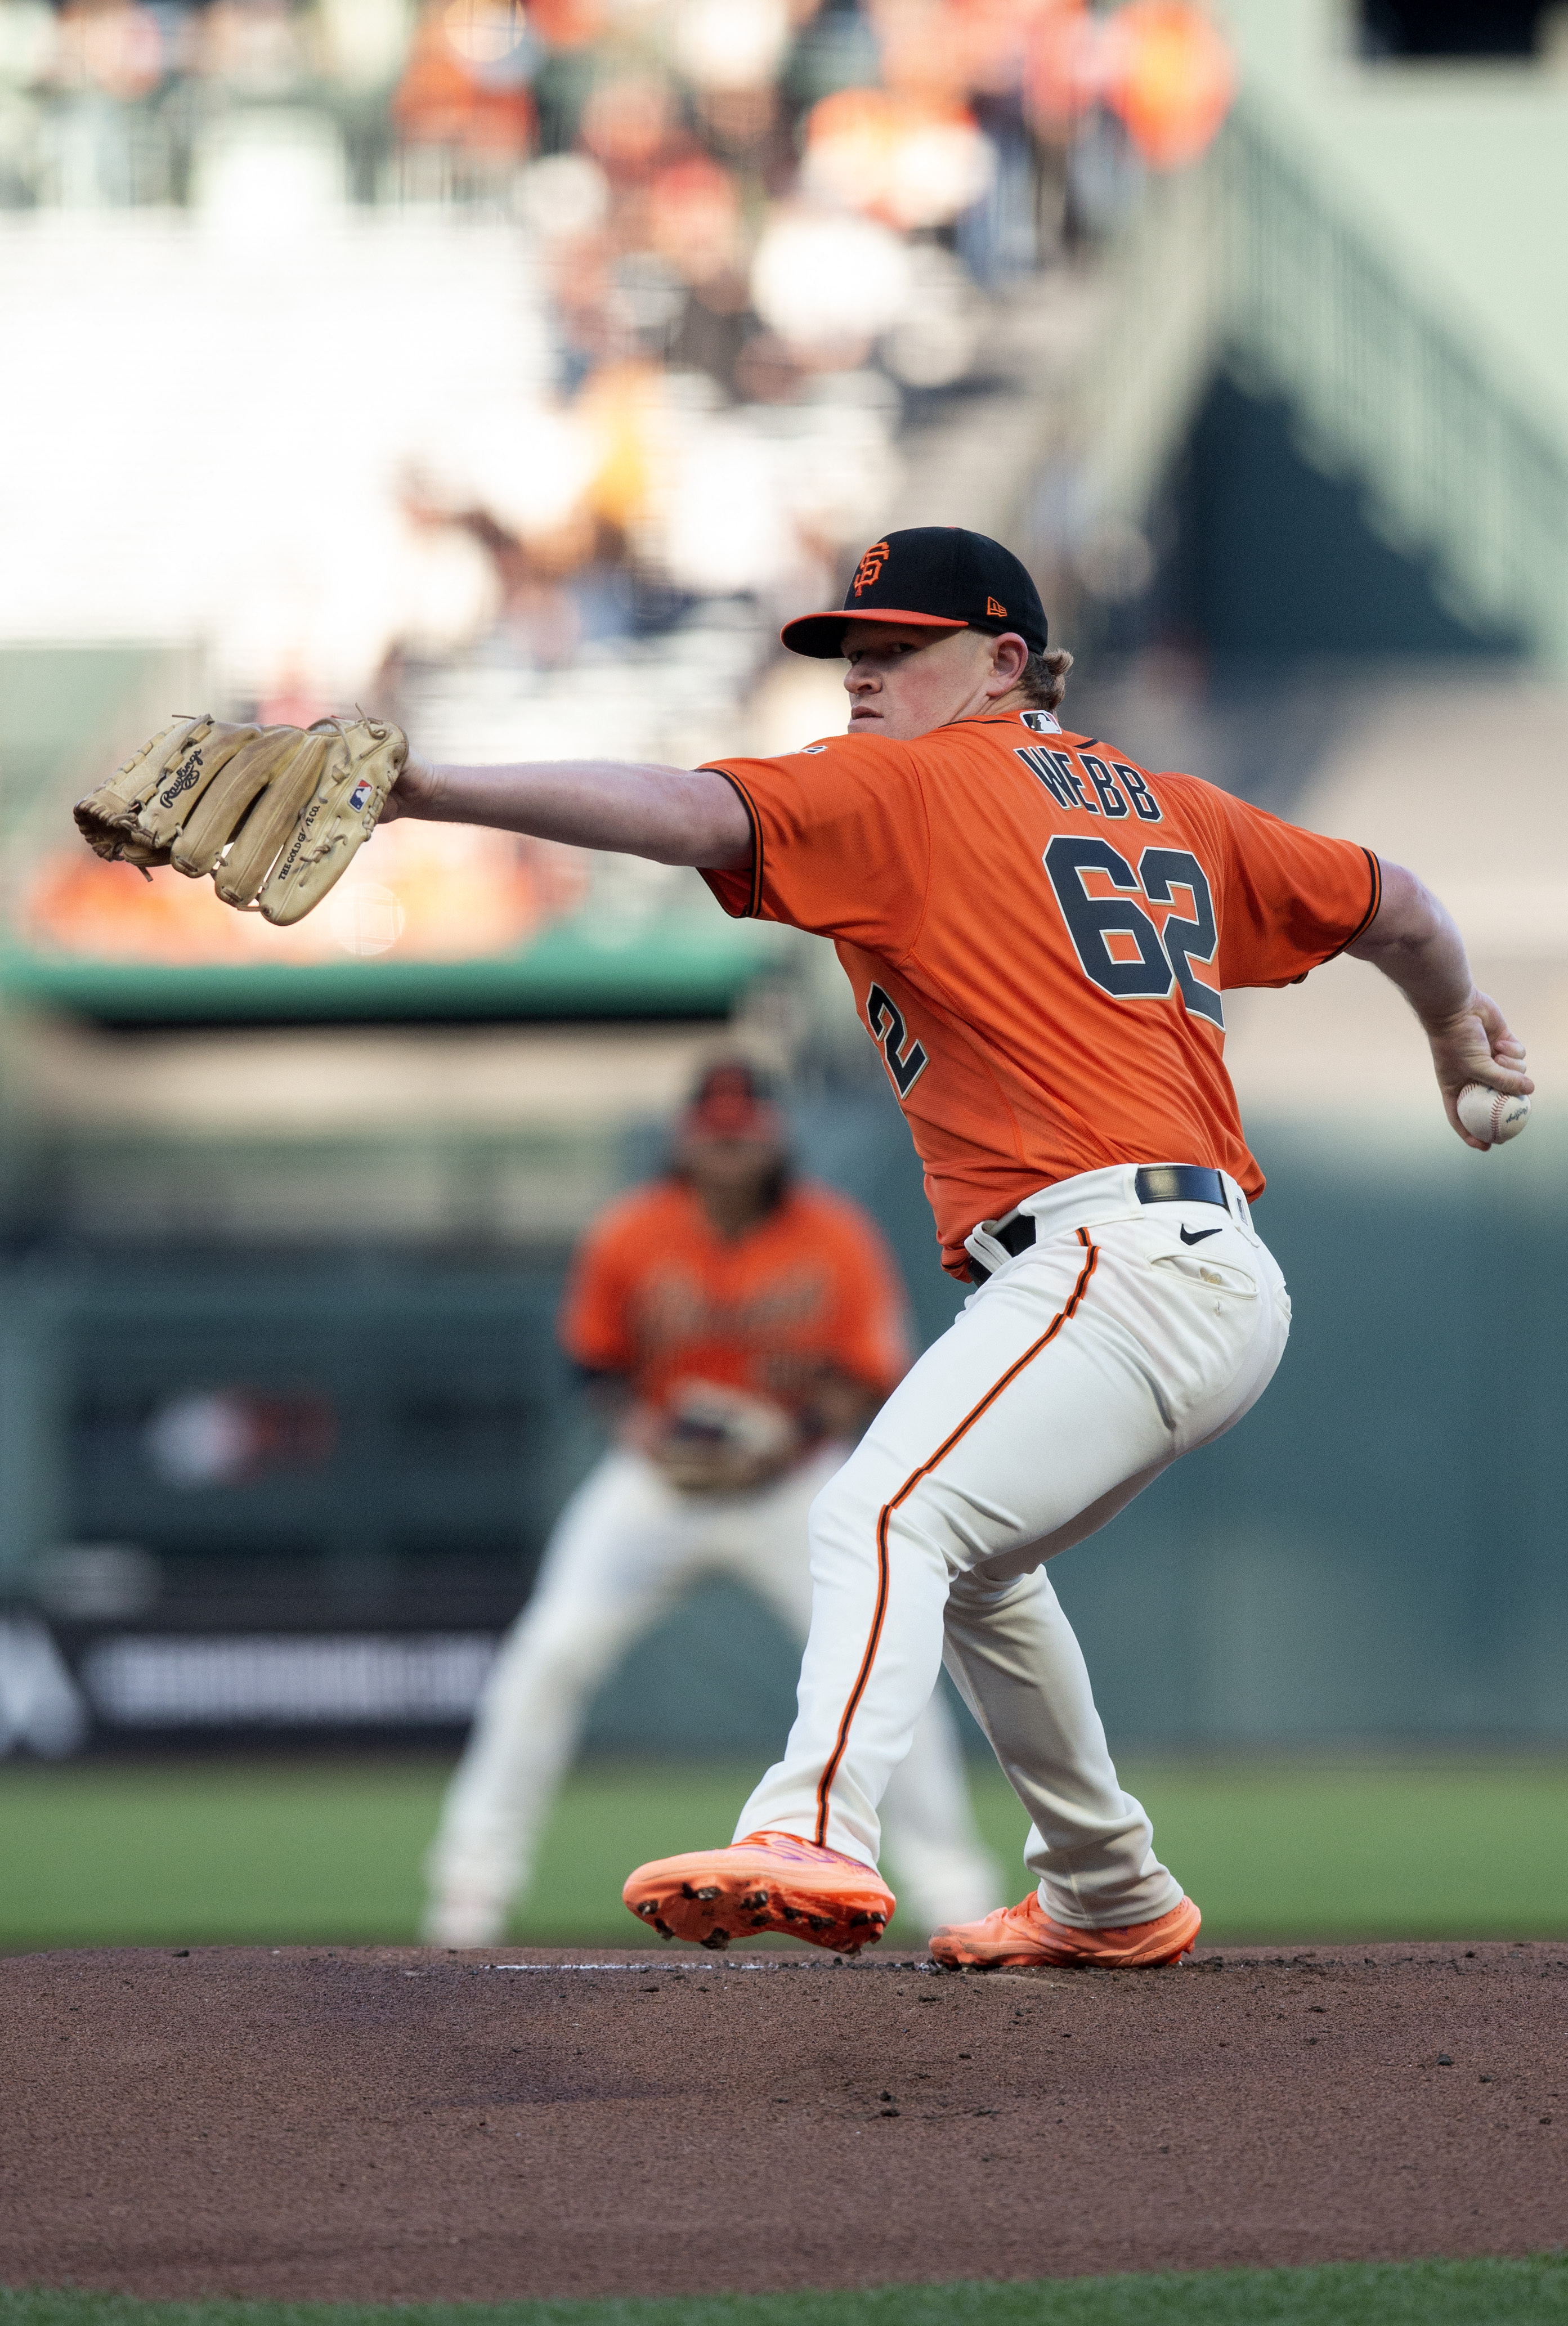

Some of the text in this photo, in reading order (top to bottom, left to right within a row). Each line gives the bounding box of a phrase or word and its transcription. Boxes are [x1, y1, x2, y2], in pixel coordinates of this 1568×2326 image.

[160, 748, 203, 809] Rawlings
[1013, 746, 1164, 824] WEBB
[278, 805, 321, 880] THE GOLD GLVE CO.
[1042, 834, 1226, 1033] 62
[866, 982, 930, 1100] 2
